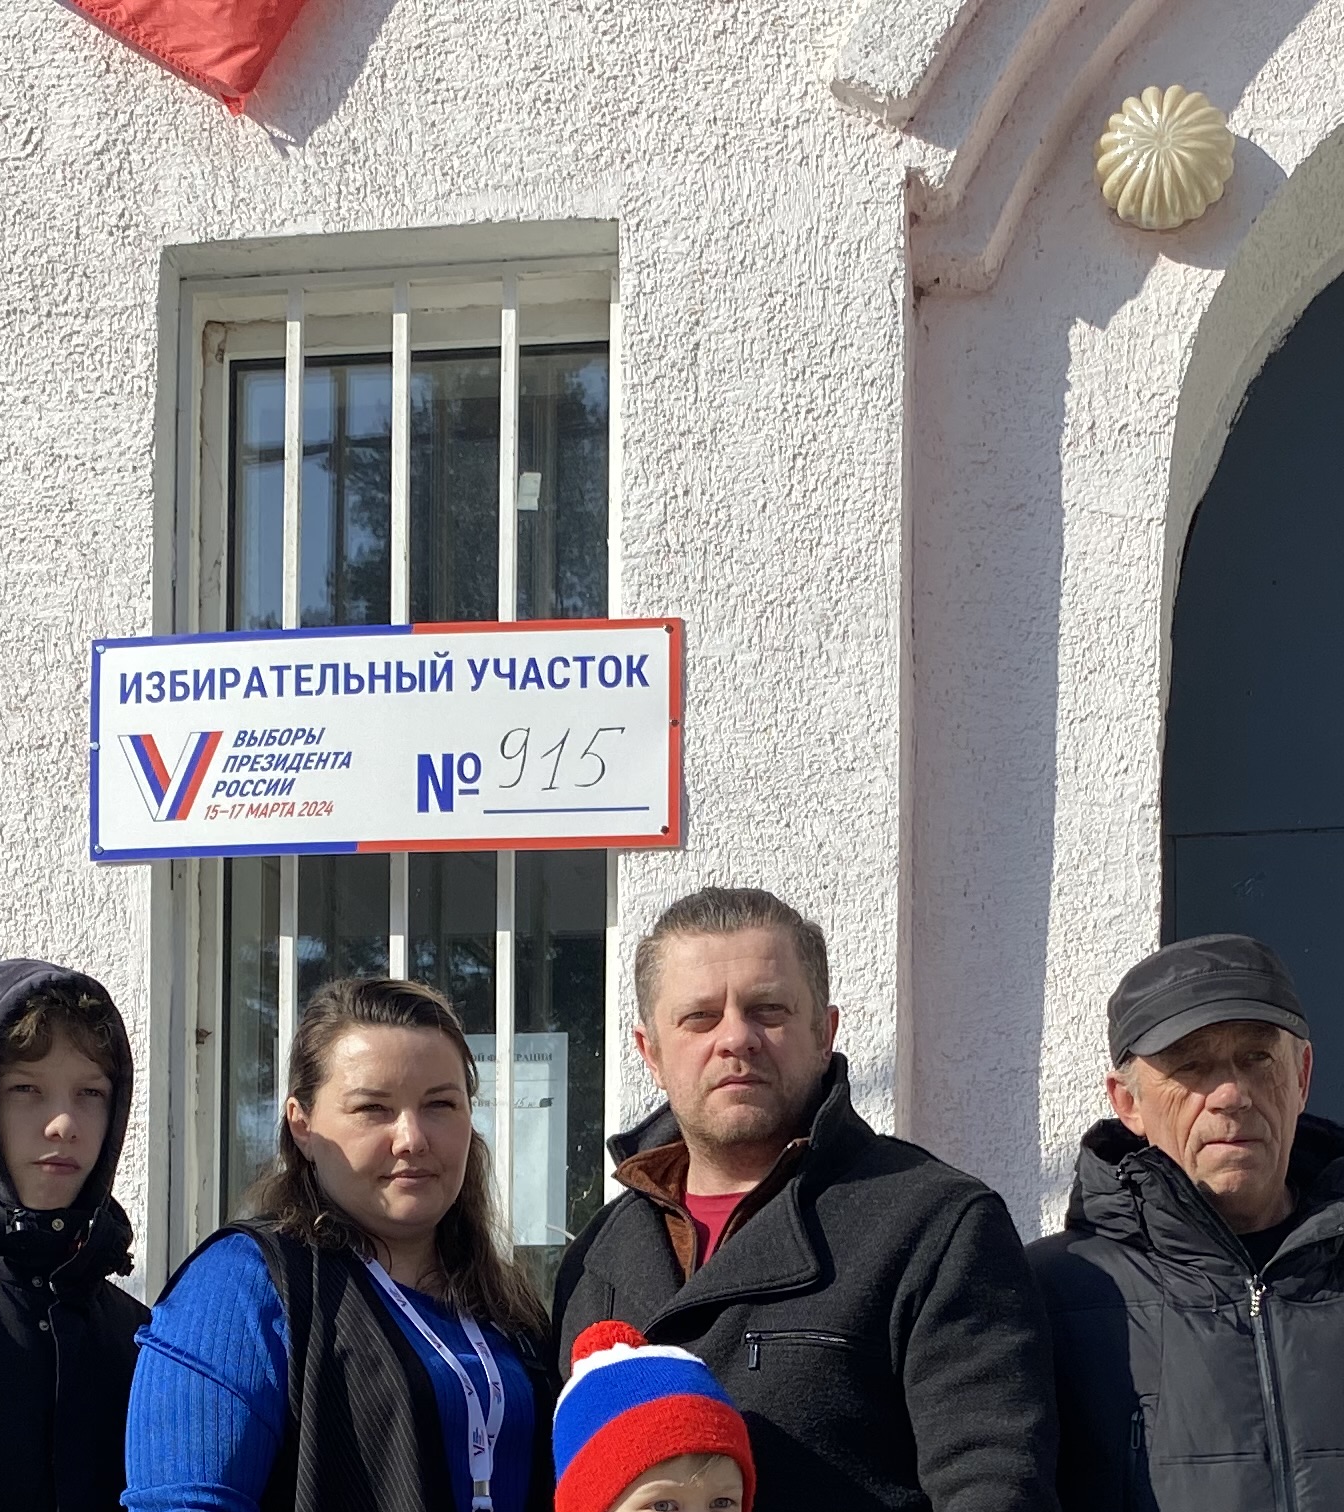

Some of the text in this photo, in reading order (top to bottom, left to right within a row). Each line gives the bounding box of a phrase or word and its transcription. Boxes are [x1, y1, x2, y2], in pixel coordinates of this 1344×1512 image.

[119, 652, 650, 704] ИЗБИРАТЕЛЬНЫЙ УЧАСТОК
[232, 727, 326, 749] ВЫБОРЫ
[221, 751, 353, 774] ПРЕЗИДЕНТА
[498, 727, 626, 792] 915
[211, 778, 297, 798] РОССИИ
[245, 802, 296, 819] МАРТА
[297, 800, 335, 818] 2024
